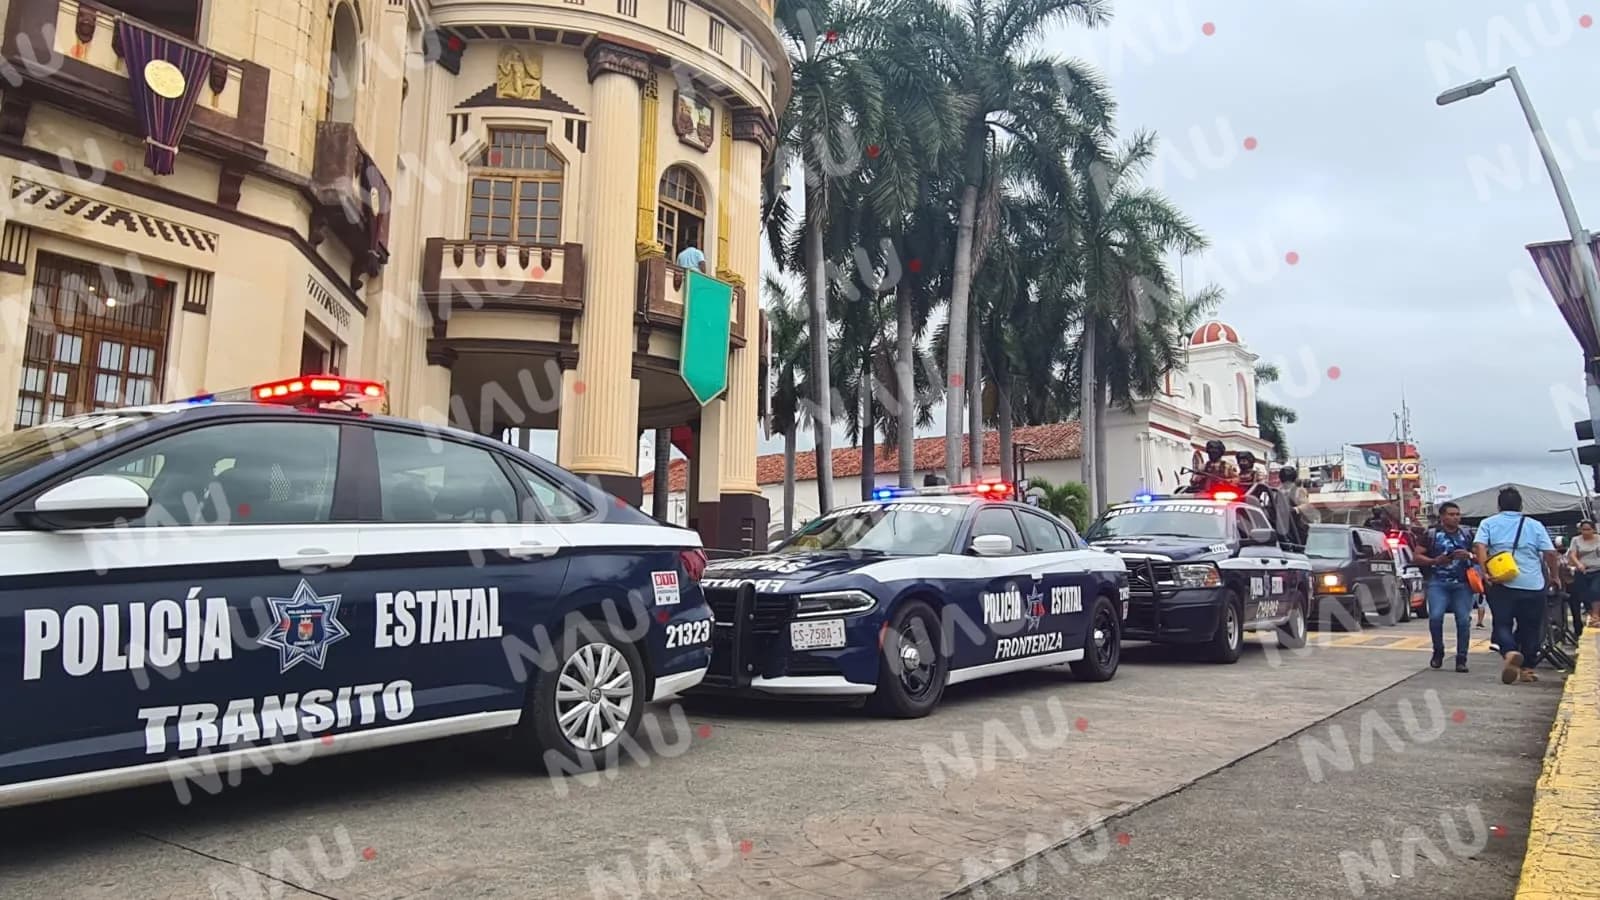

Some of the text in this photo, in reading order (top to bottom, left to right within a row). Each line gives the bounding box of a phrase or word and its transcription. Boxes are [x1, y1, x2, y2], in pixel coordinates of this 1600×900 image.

[1387, 463, 1417, 474] XXO
[984, 585, 1021, 624] POLICÍA
[1051, 586, 1082, 614] ESTATAL
[23, 587, 502, 681] POLICÍA ESTATAL
[665, 620, 711, 648] 21323
[792, 626, 843, 642] CS-758A-1
[995, 632, 1063, 659] FRONTERIZA
[137, 680, 414, 755] TRANSITO
